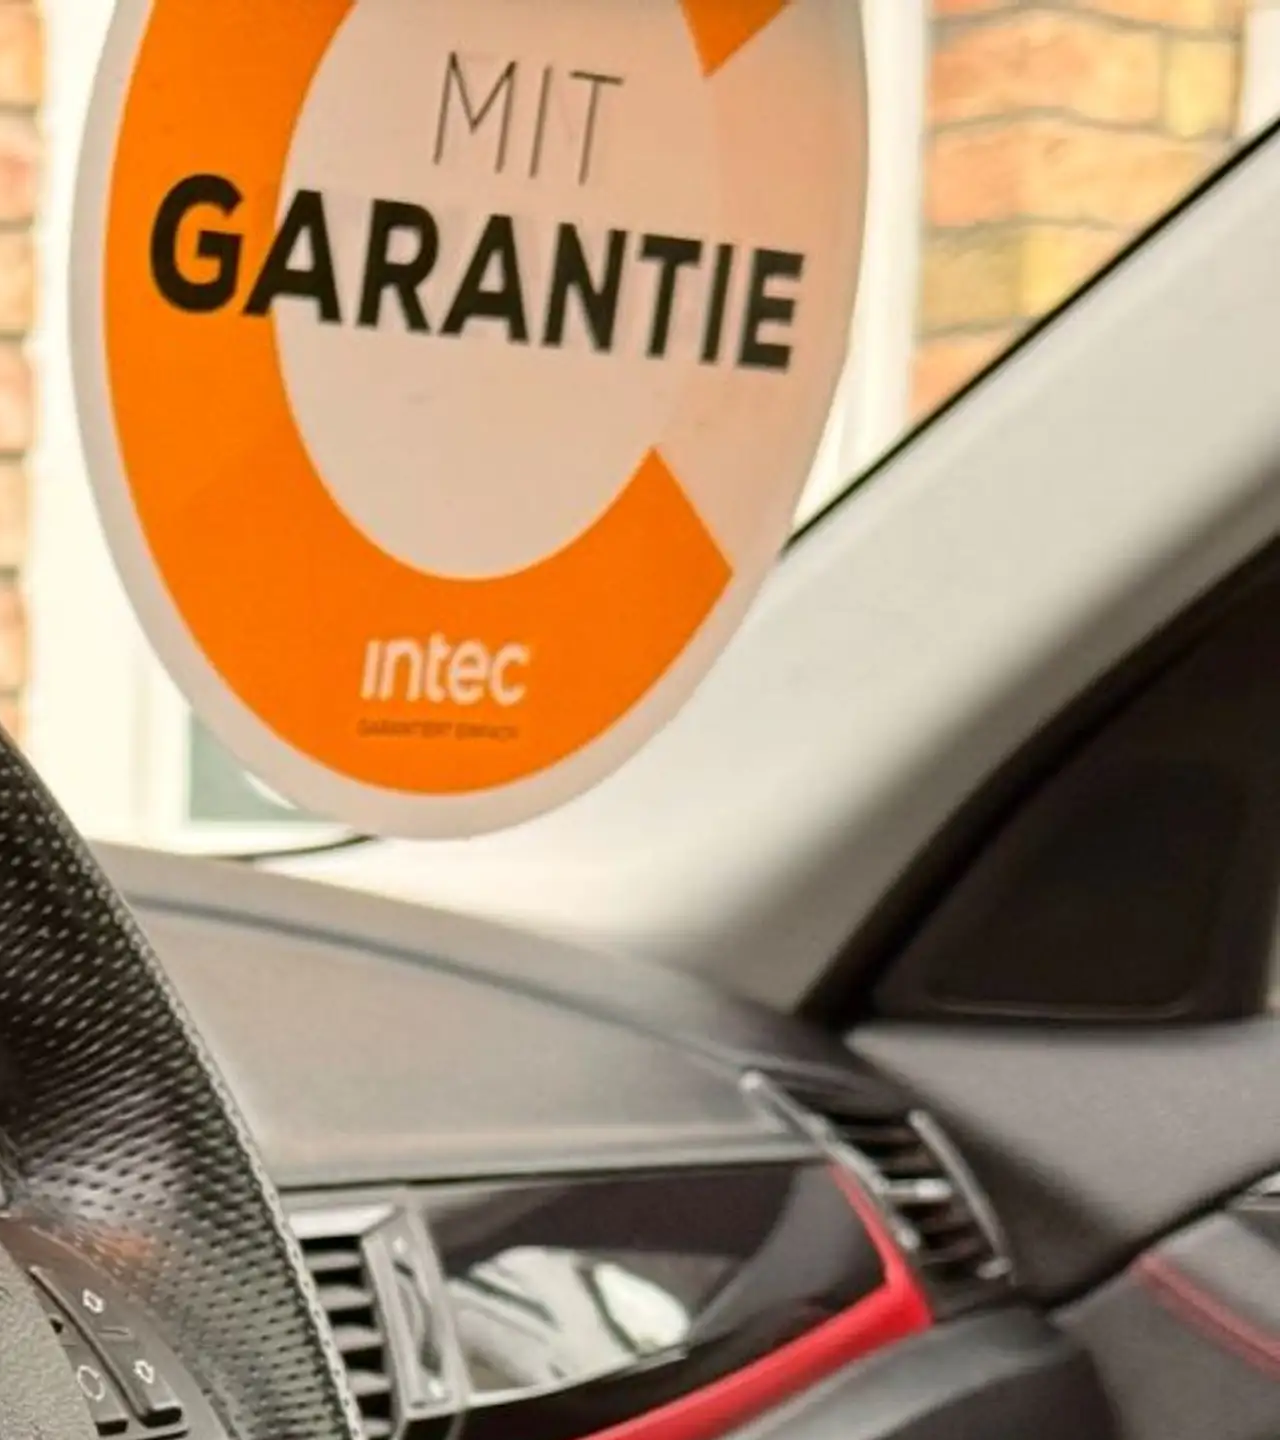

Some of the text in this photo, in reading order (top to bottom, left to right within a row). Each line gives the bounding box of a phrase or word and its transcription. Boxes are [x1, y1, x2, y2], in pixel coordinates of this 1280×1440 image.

[432, 50, 625, 186] MIT
[148, 172, 806, 374] GARANTIE
[359, 630, 532, 707] intec
